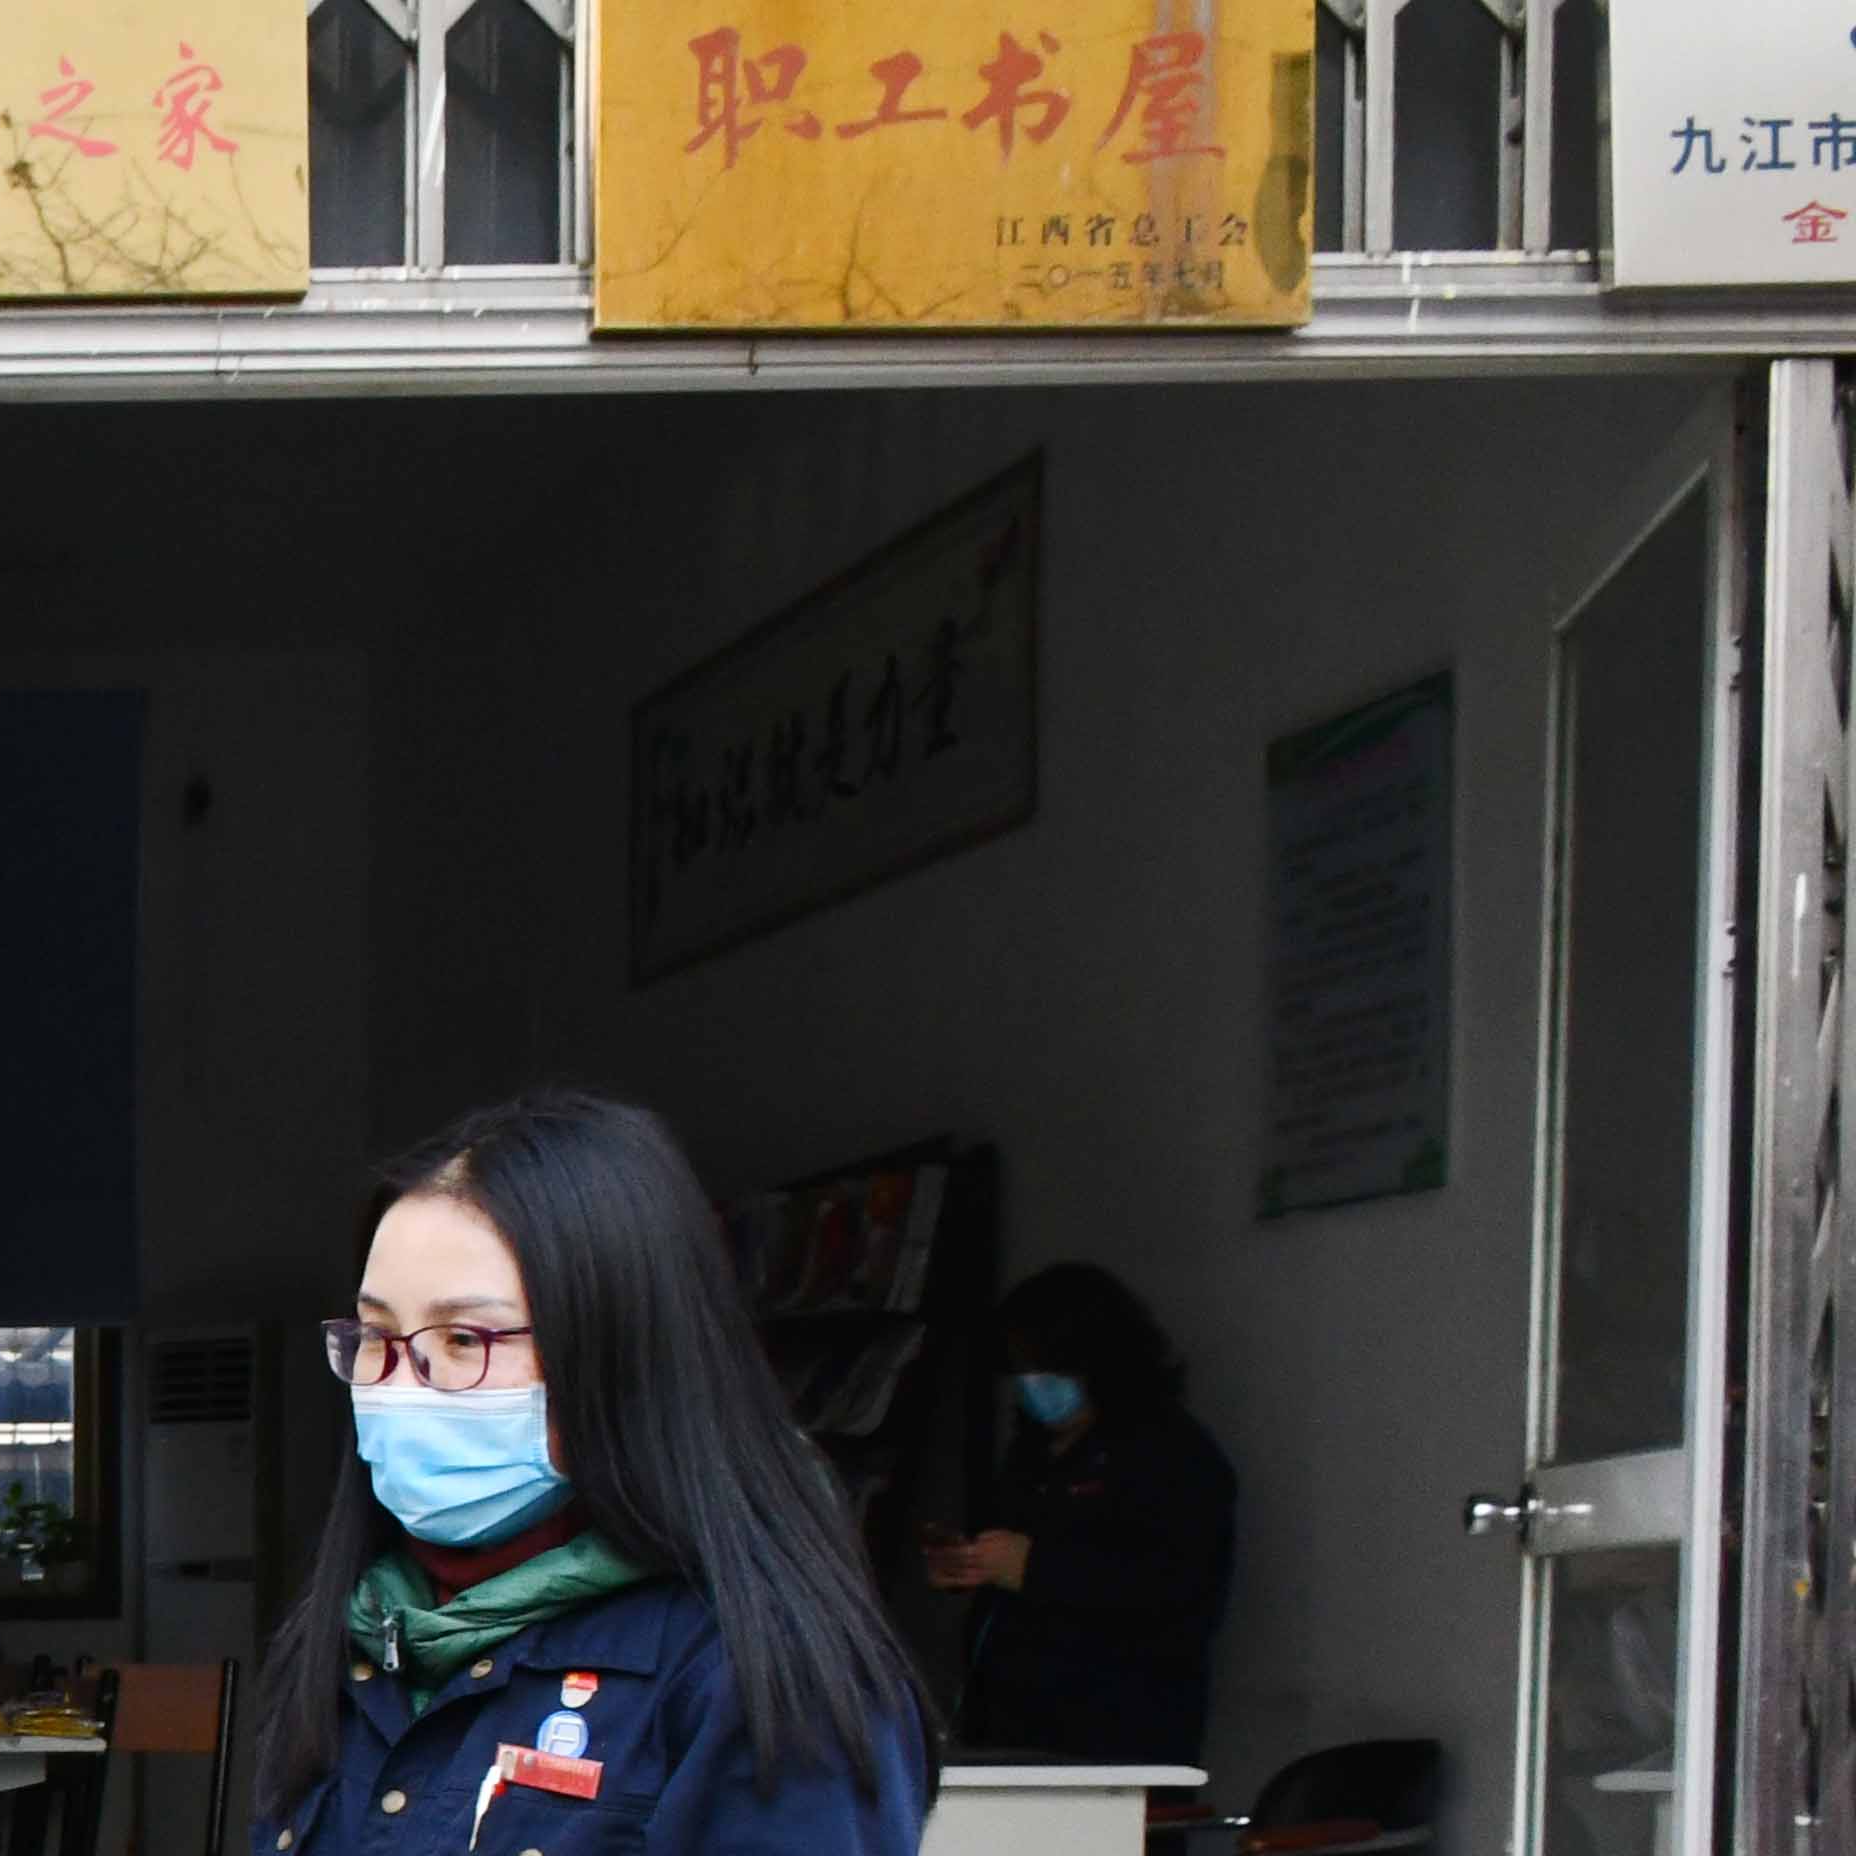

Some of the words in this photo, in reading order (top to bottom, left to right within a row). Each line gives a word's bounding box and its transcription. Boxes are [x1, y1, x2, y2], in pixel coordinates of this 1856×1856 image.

[682, 29, 1226, 170] 职工书屋
[1670, 112, 1856, 174] 九江市
[996, 213, 1248, 247] 江西省总工会
[1782, 201, 1847, 243] 金
